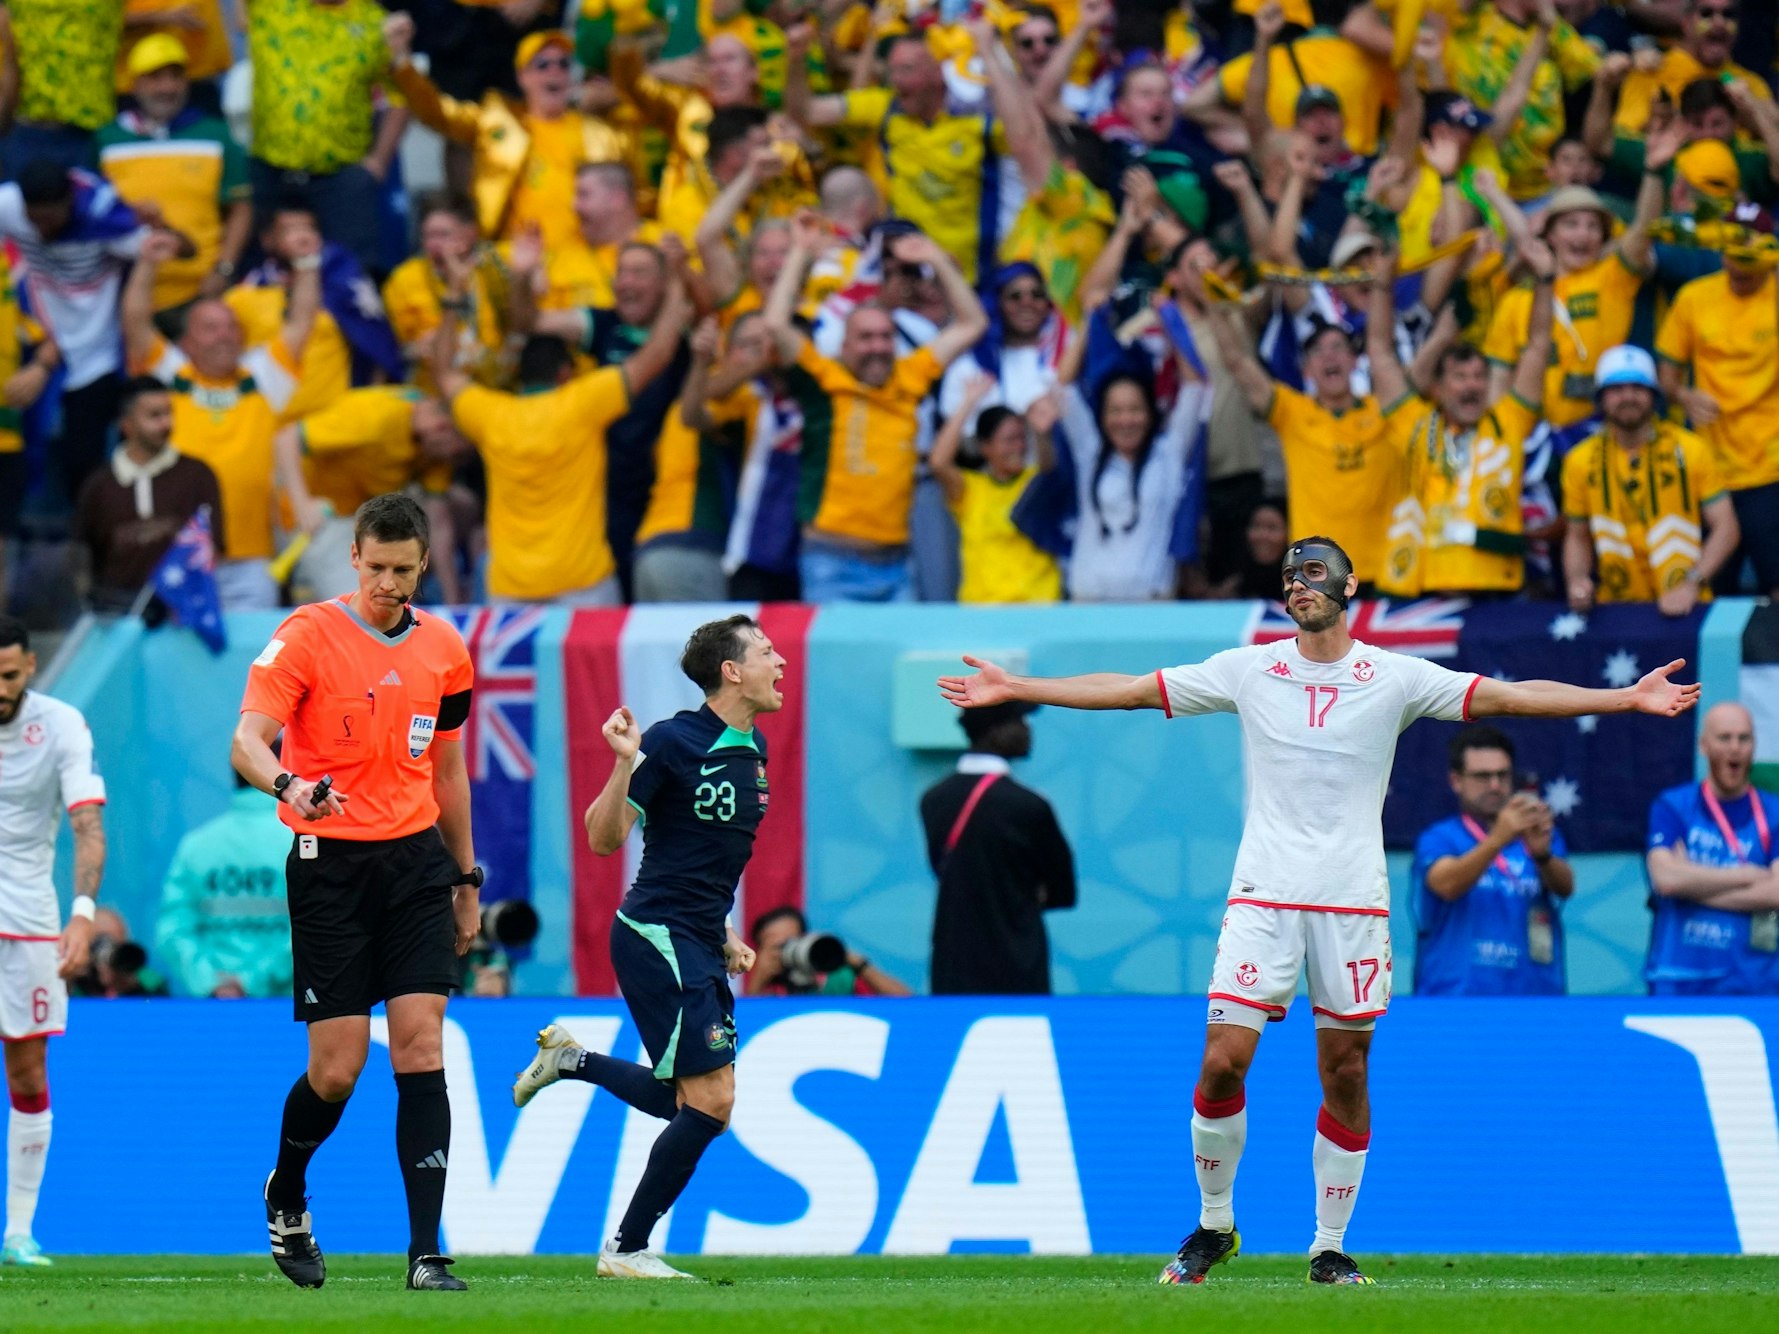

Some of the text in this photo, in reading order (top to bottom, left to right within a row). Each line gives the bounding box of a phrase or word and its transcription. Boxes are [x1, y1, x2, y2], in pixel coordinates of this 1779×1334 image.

[1305, 685, 1338, 728] 17
[412, 717, 434, 730] FIFA
[410, 734, 431, 743] REFEREE
[694, 780, 736, 822] 23
[1346, 958, 1379, 1003] 17
[32, 985, 49, 1025] 6
[1195, 1154, 1221, 1171] FTF
[1325, 1184, 1356, 1200] FTF
